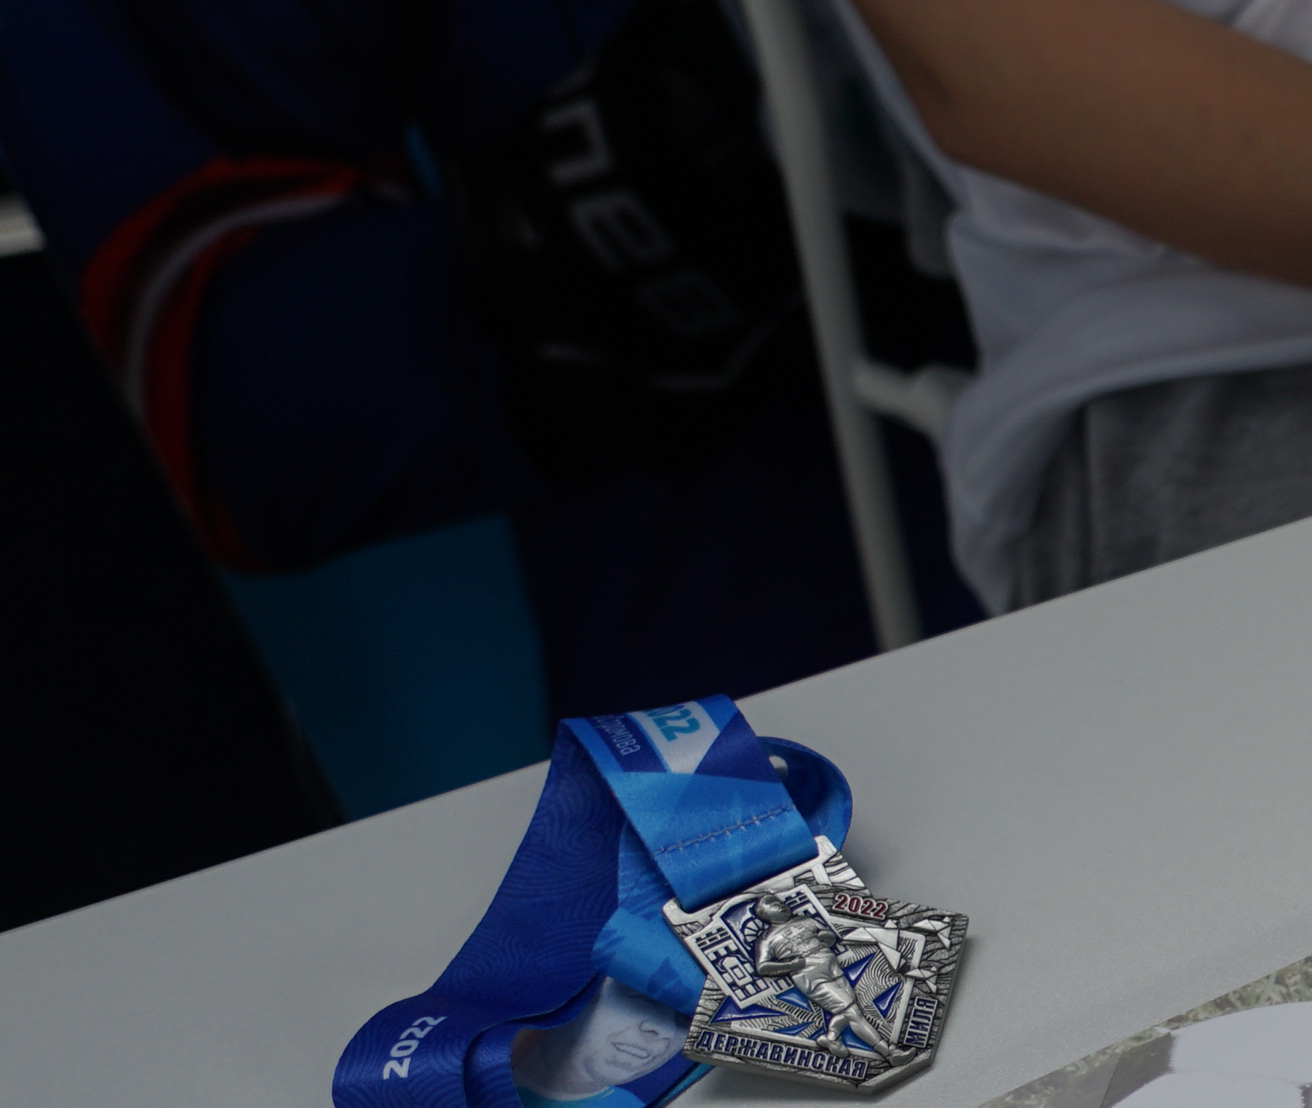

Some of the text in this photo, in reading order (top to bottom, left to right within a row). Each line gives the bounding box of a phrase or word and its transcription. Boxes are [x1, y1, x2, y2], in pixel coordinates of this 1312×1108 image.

[834, 893, 888, 921] 2022
[382, 1015, 449, 1081] 2022
[903, 996, 938, 1049] МИЛЯ
[696, 1029, 870, 1080] ДЕРЖАВИНСКАЯ
